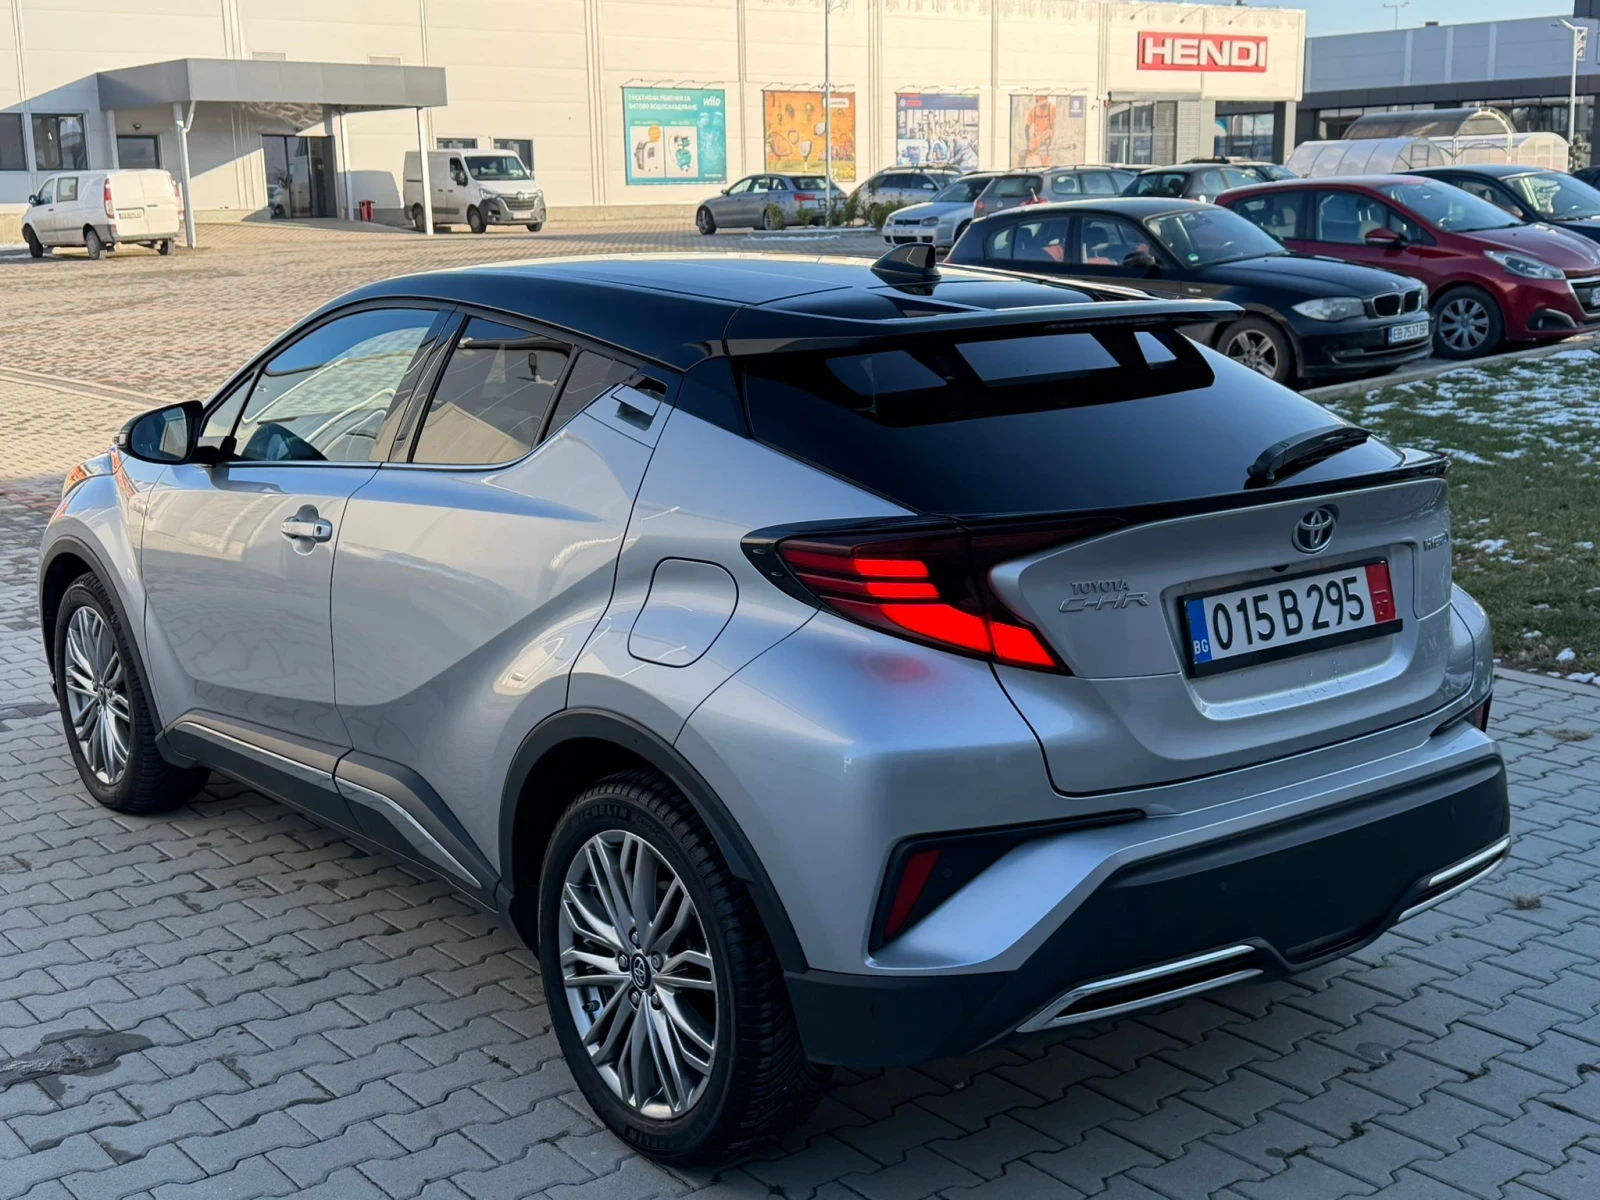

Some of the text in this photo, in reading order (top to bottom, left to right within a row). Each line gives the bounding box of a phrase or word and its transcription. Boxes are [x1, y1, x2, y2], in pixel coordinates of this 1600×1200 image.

[1142, 37, 1266, 67] HENDI
[703, 96, 721, 107] wilo
[1070, 578, 1129, 595] TOYOTA
[1058, 591, 1149, 612] C-HR
[1193, 638, 1209, 654] BG
